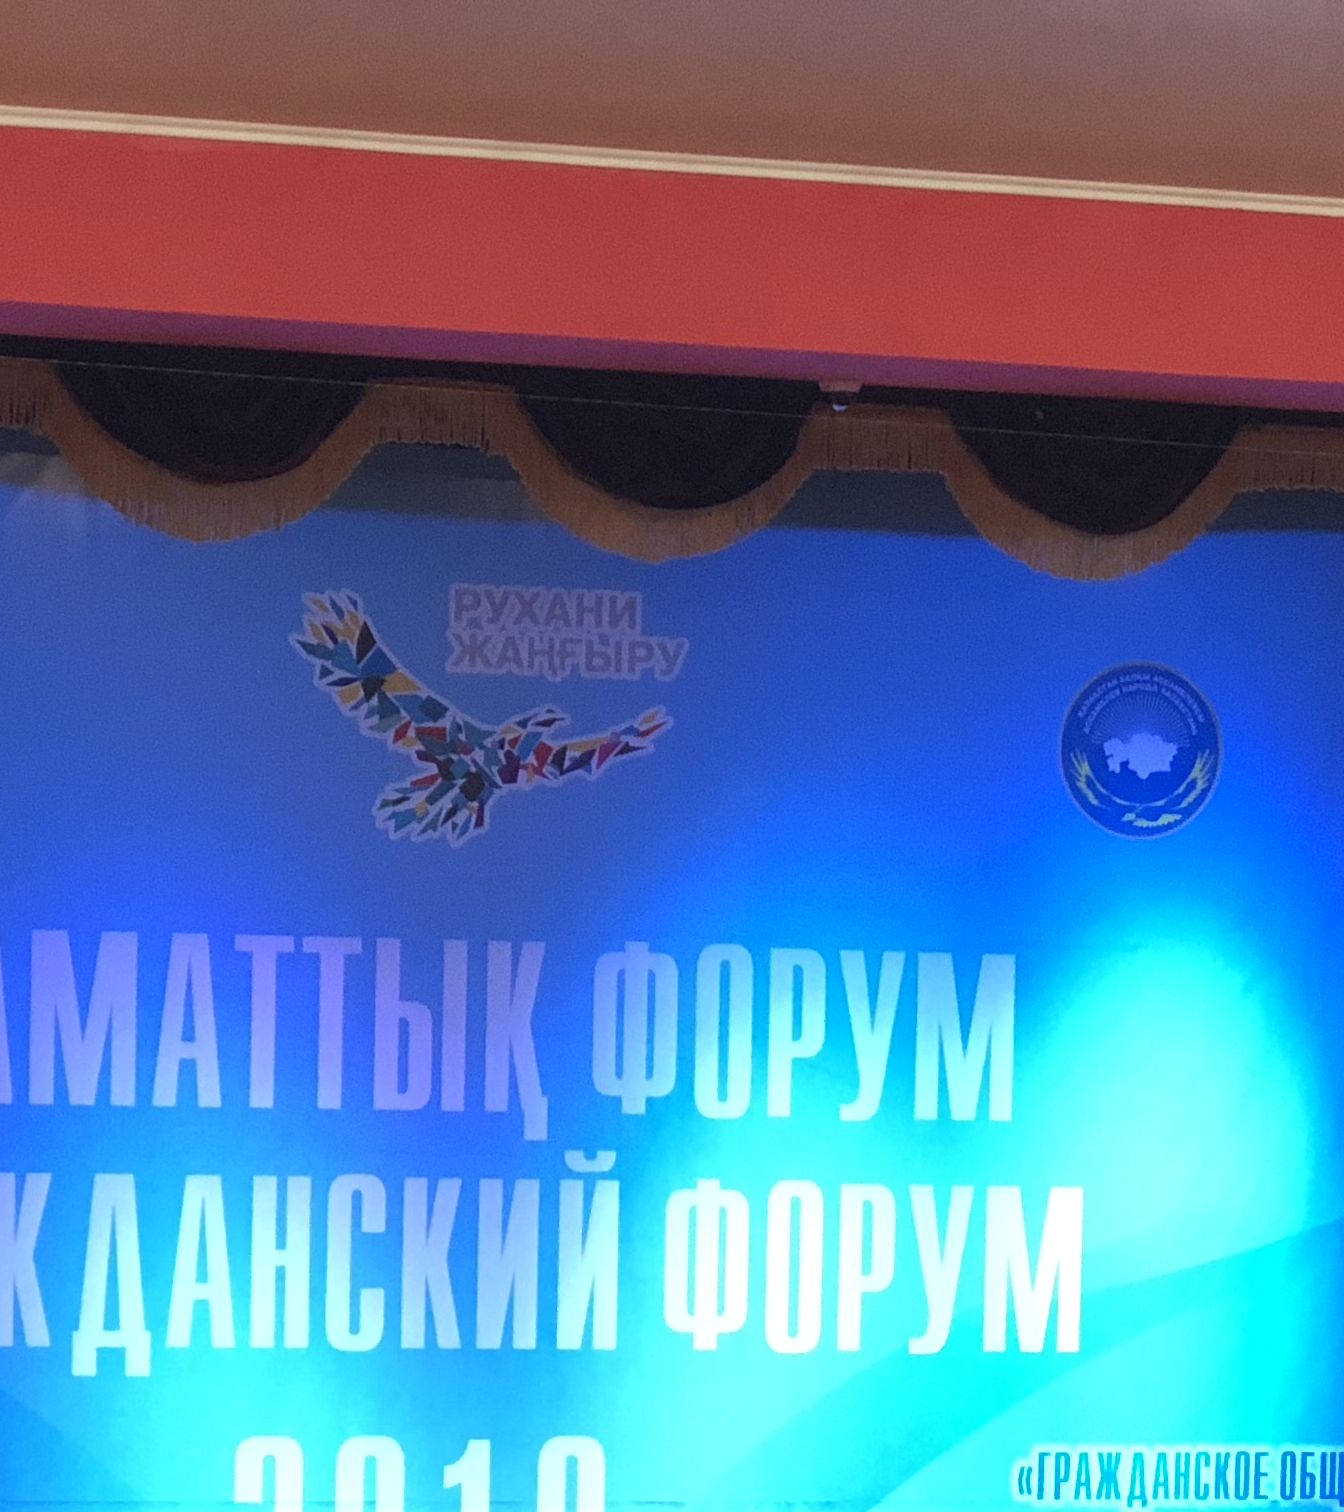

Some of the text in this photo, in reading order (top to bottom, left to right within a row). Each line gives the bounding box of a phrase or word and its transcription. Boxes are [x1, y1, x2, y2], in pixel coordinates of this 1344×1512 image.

[453, 588, 637, 630] РУХАНИ
[591, 940, 1017, 1122] ФОРУМ
[663, 1178, 1085, 1355] ФОРУМ
[1018, 1450, 1270, 1507] «ГРАЖДАНСКОЕ
